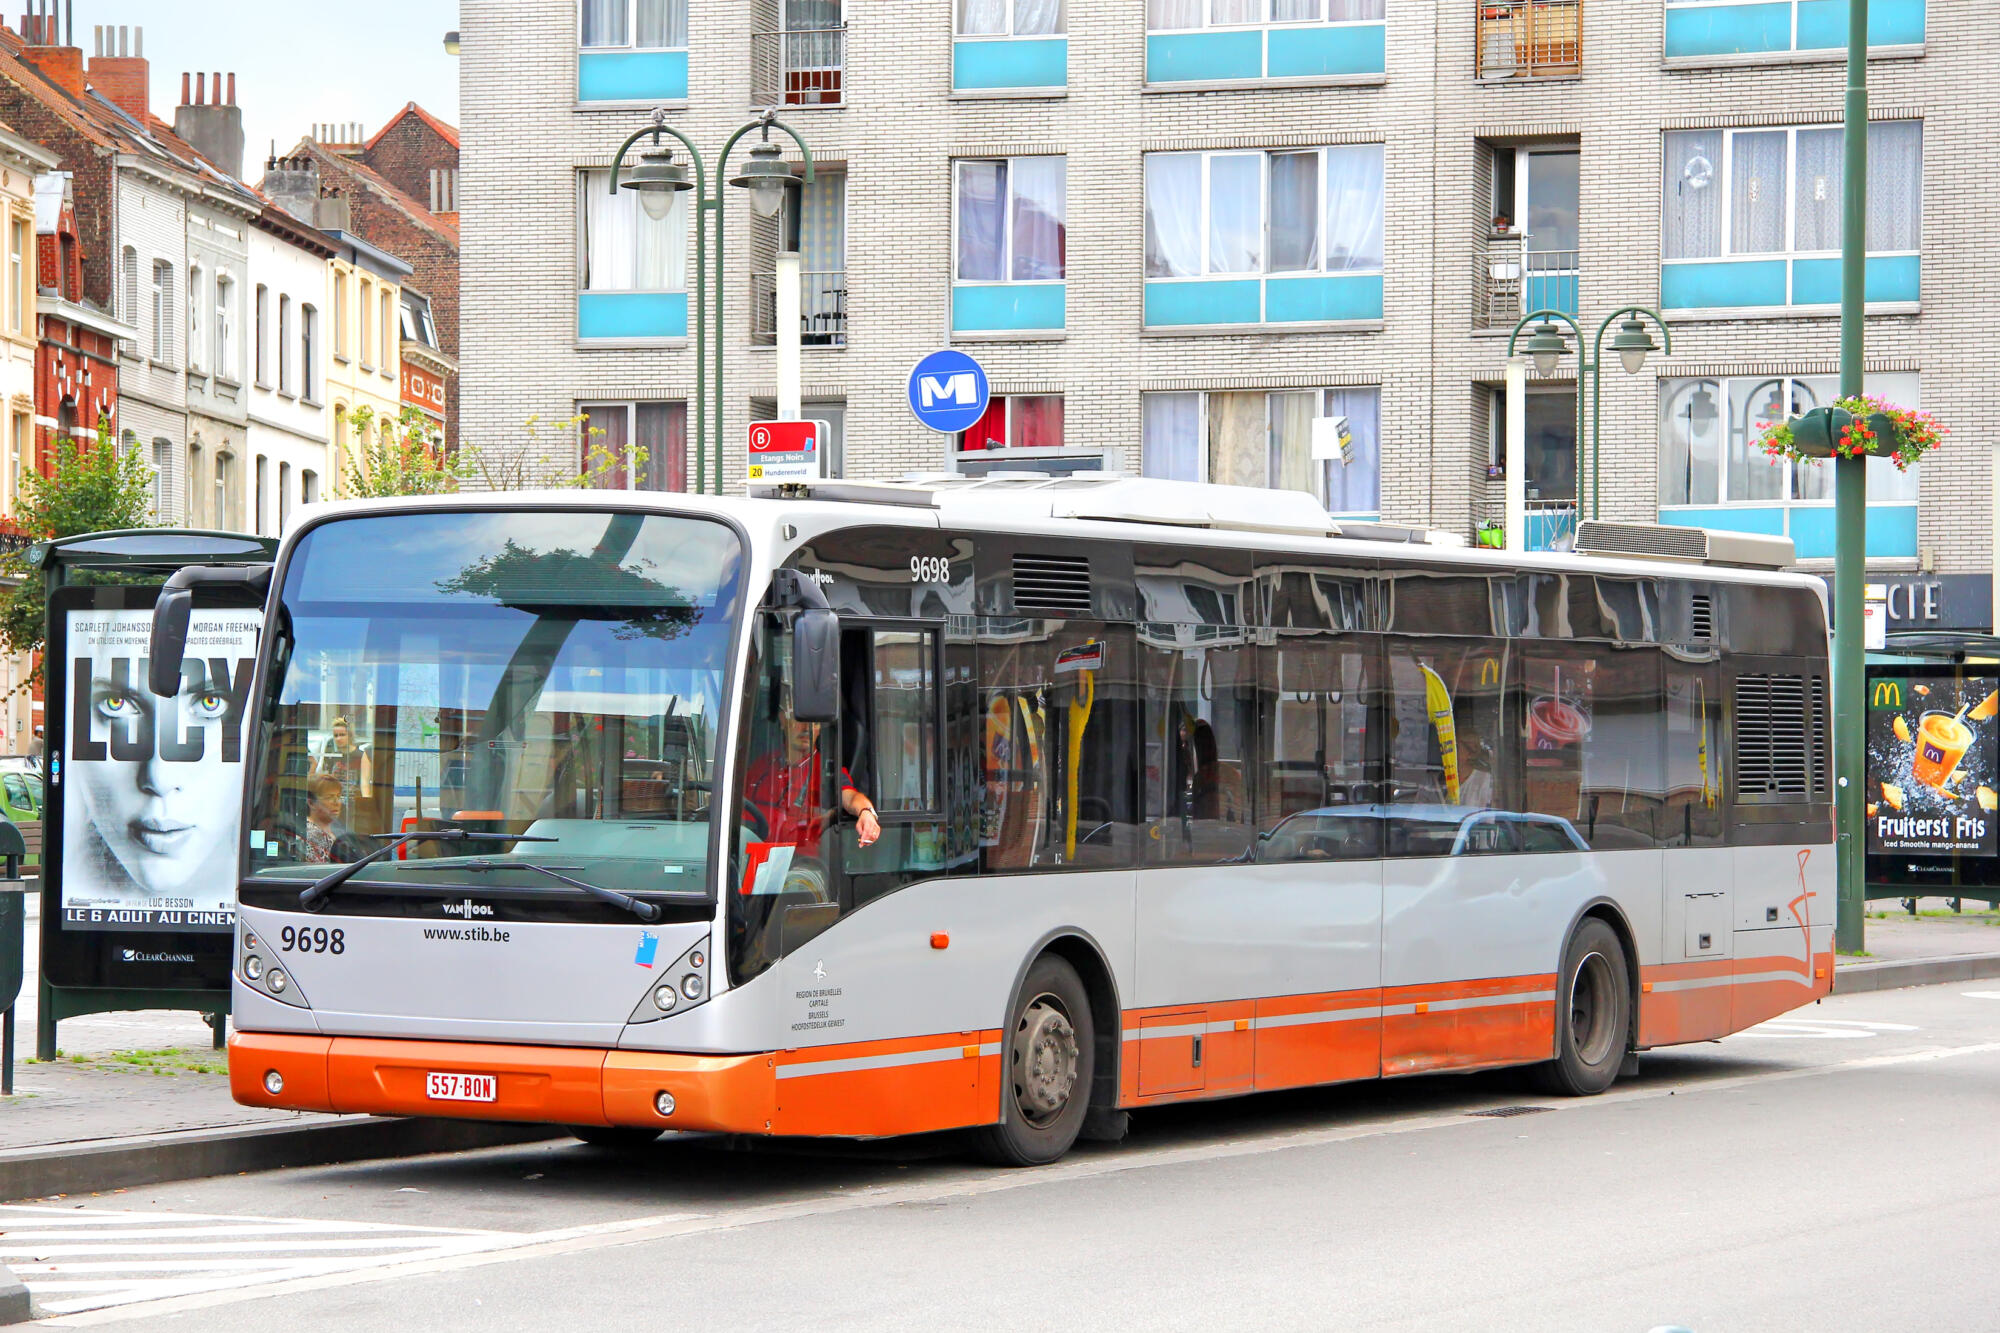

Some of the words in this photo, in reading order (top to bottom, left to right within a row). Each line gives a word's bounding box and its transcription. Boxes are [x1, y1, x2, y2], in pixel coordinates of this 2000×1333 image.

[920, 373, 978, 408] M
[757, 432, 765, 444] B
[760, 454, 784, 464] Etangs
[786, 453, 804, 461] Noirs
[752, 468, 763, 477] 20
[765, 469, 807, 477] Hunderenveld
[911, 556, 950, 583] 9698
[75, 622, 110, 633] SCARLETT
[112, 622, 152, 633] JOHANSSO
[193, 622, 223, 633] MORGAN
[226, 623, 259, 633] FREEMAN
[124, 637, 148, 645] MOYENNE
[184, 637, 208, 645] PACITÉS
[72, 657, 256, 762] LUCY
[1878, 815, 1949, 838] Fruiterst
[1956, 816, 1985, 839] Fris
[1884, 840, 1898, 848] Iced
[1899, 840, 1930, 849] Smoothie
[1931, 841, 1979, 850] mango-ananas
[149, 897, 162, 908] LUC
[165, 897, 194, 909] BESSON
[67, 909, 85, 922] LE
[91, 910, 102, 922] 6
[107, 910, 153, 924] AOUT
[159, 911, 181, 924] AU
[187, 912, 236, 926] CINEM
[281, 925, 345, 955] 9698
[423, 926, 510, 943] www.stib.be
[796, 990, 812, 999] REGION
[813, 990, 819, 998] DE
[819, 988, 842, 996] BRUXELLES
[809, 999, 829, 1007] CAPITALE
[808, 1011, 829, 1019] BRUSSELS
[828, 1019, 845, 1027] GEWEST
